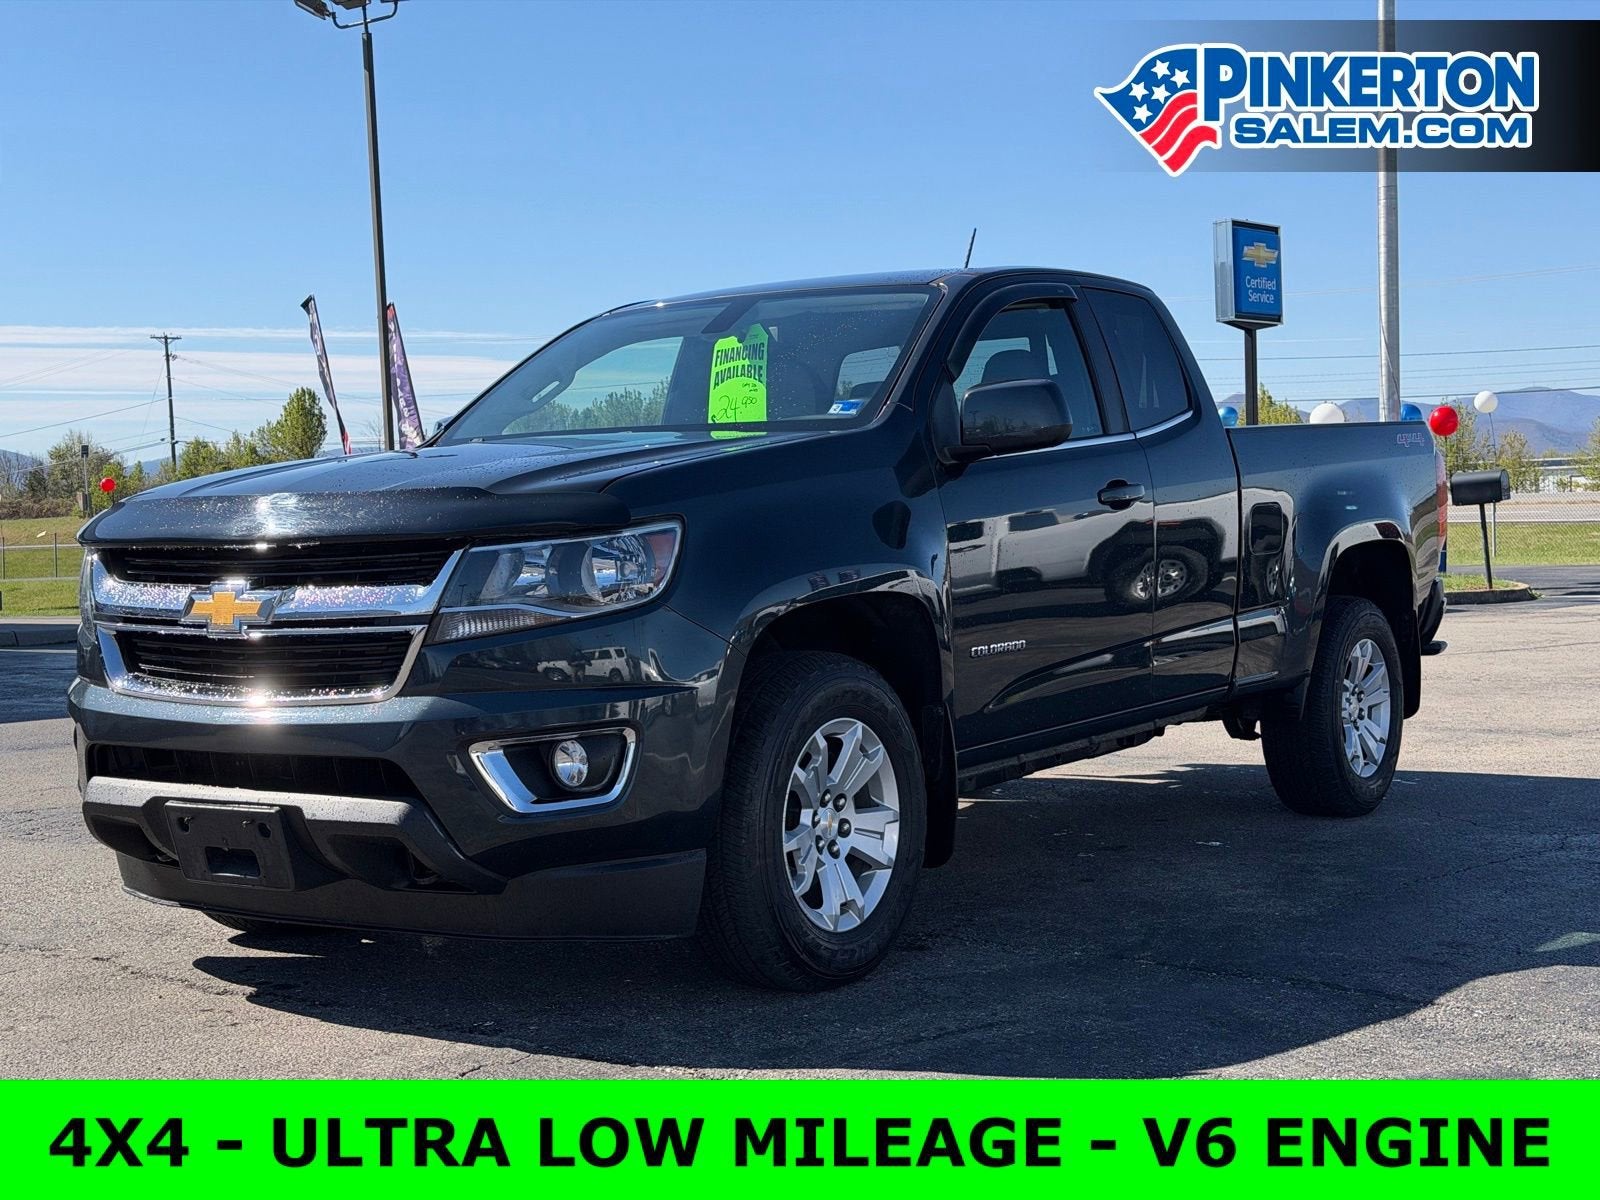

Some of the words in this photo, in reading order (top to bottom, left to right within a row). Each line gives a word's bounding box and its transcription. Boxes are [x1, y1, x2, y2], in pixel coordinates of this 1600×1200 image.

[1245, 276, 1276, 290] Certified
[1248, 291, 1275, 304] Service
[714, 342, 765, 368] FINANCING
[713, 363, 764, 391] AVAILABLE
[970, 639, 1026, 658] COLORADO
